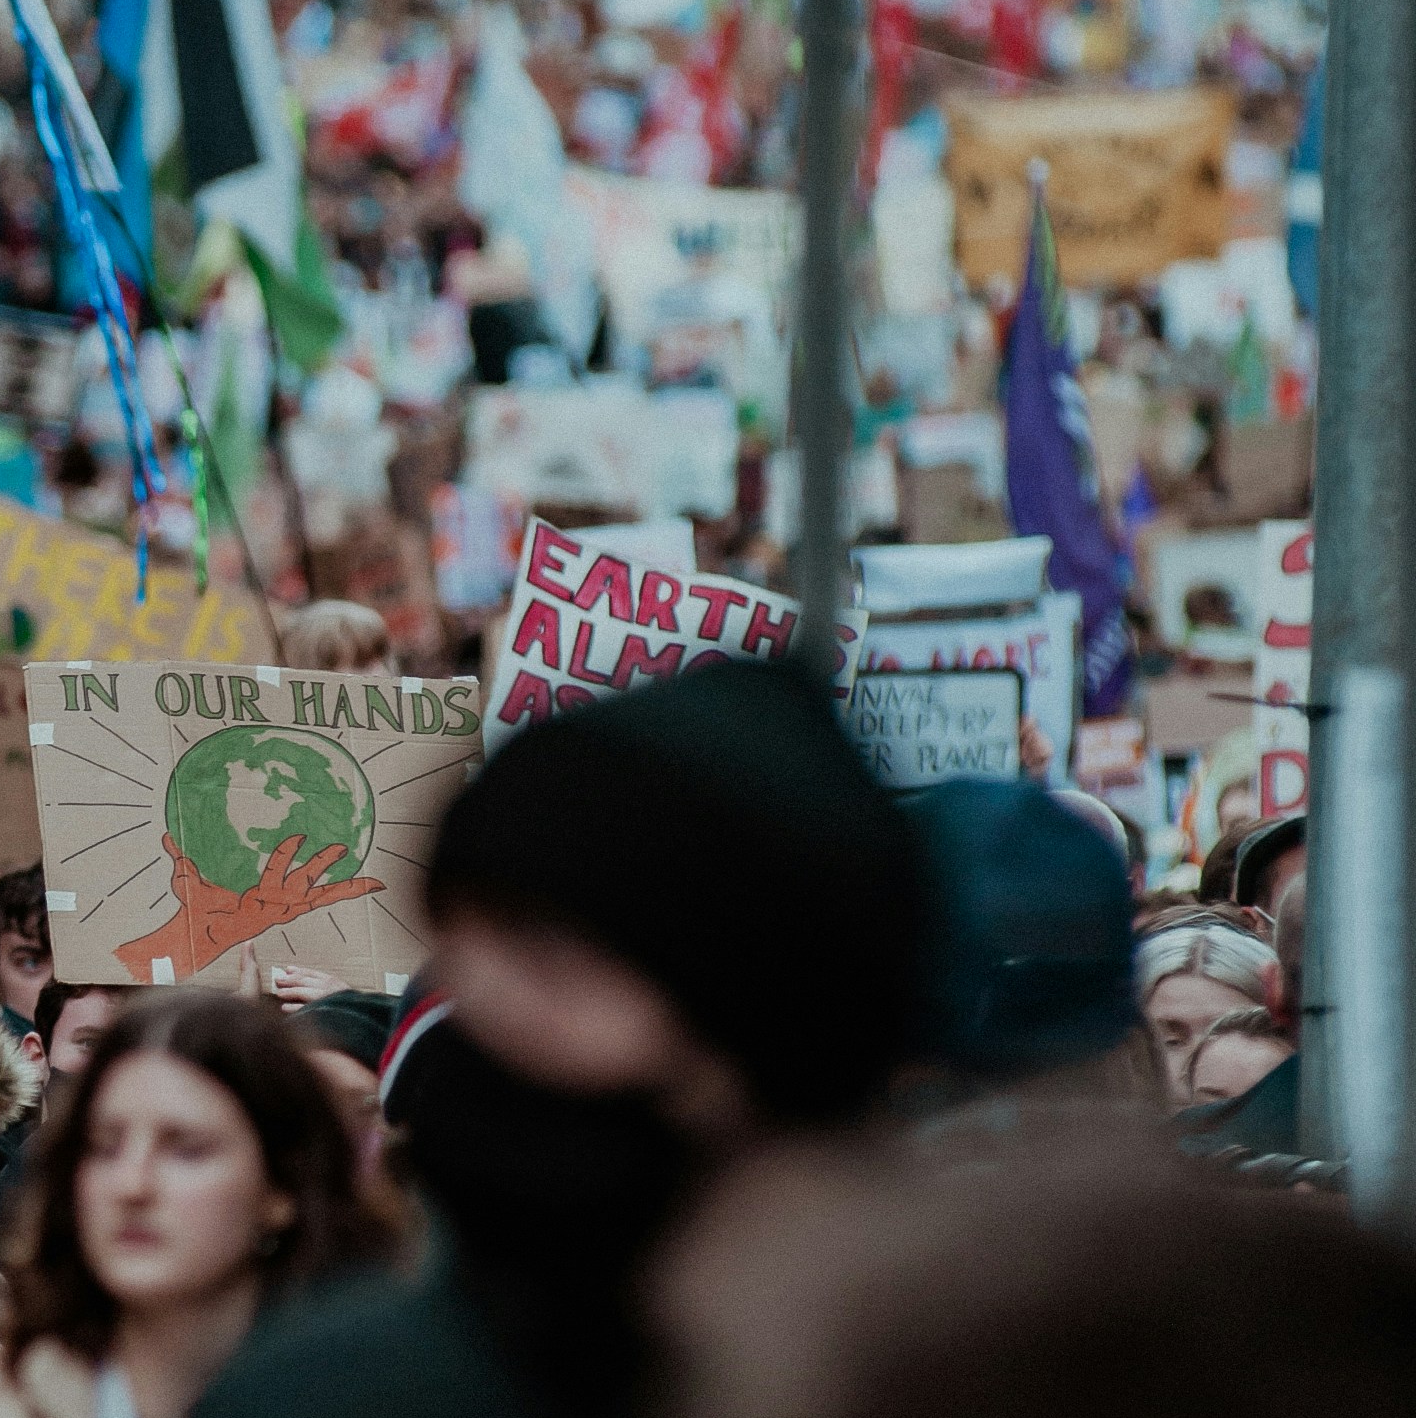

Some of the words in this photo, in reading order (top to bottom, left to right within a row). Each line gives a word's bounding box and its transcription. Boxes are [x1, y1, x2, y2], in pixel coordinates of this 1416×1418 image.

[59, 672, 121, 714] IN
[154, 671, 271, 723] OUR
[288, 679, 481, 737] HANDS
